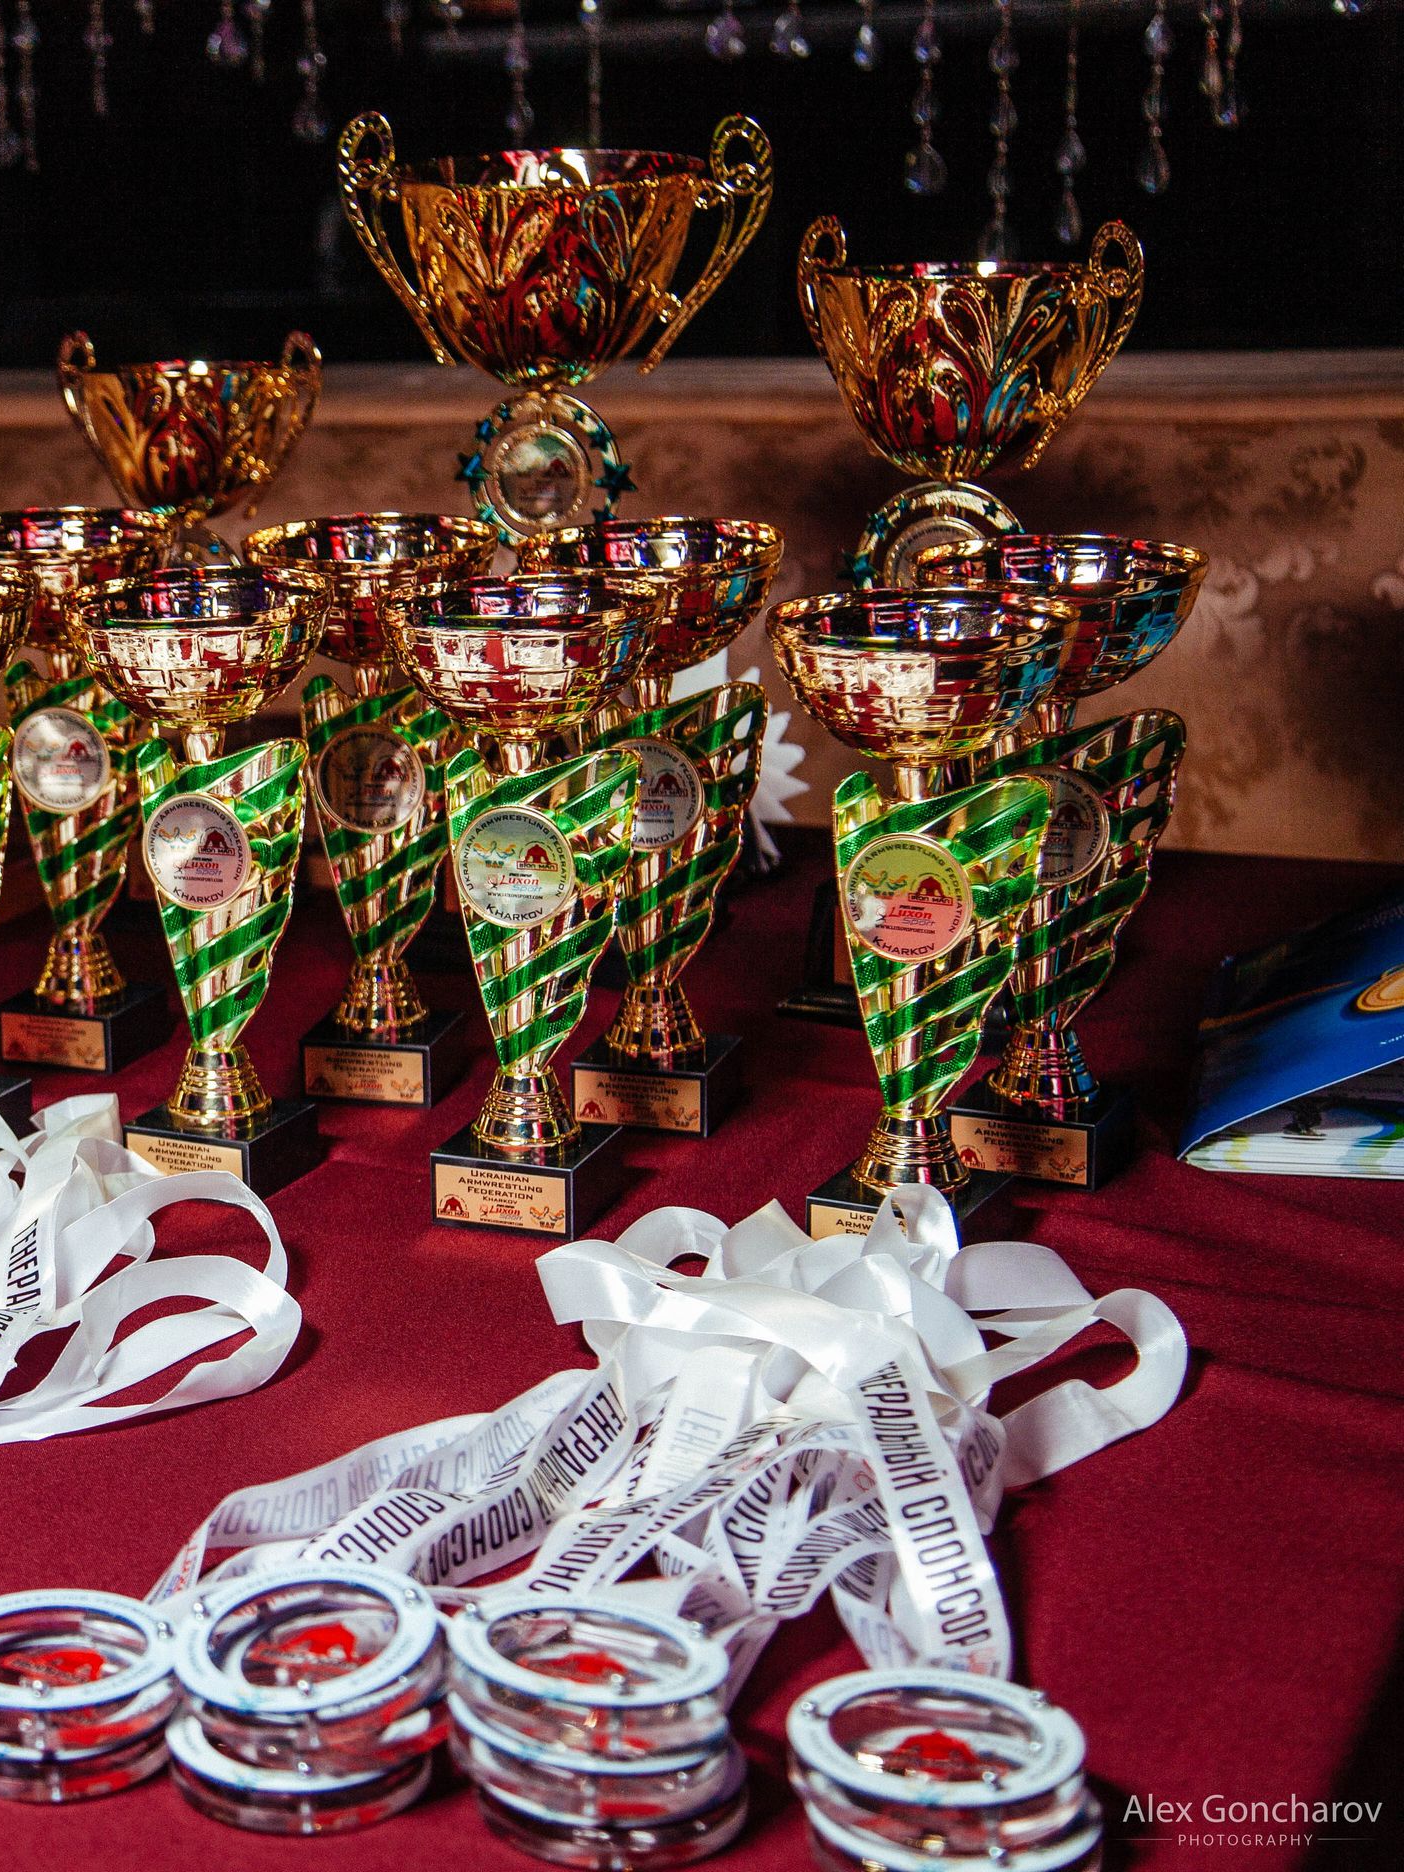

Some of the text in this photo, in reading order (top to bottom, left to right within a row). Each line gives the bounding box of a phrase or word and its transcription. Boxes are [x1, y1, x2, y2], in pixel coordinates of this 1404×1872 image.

[159, 800, 226, 822] ARMWRESTLING
[226, 820, 245, 881] FEDERATION
[460, 813, 569, 898] UKRAINIAN ARMWRESTLING FEDERATION
[499, 873, 540, 886] Luxon
[848, 843, 964, 934] UKRAINIAN ARMWRESTLING FEDERATION
[172, 886, 224, 903] KHARKOV
[485, 903, 544, 921] KHARKOV
[888, 906, 933, 919] Luxon
[871, 935, 936, 956] KHARKOV
[147, 1146, 222, 1164] ARMWRESTLING
[158, 1139, 210, 1153] UKRAINIAN
[155, 1154, 214, 1170] FEDERATION
[458, 1176, 543, 1194] ARMWRESTLING
[470, 1169, 530, 1184] UKRAINIAN
[467, 1185, 534, 1201] FEDERATION
[489, 1205, 521, 1216] Luxon
[5, 1217, 43, 1317] ГЕНЕРА
[319, 1490, 447, 1565] СПОНС
[427, 1486, 535, 1587] СПОНСОР
[528, 1522, 629, 1594] СПОНС
[761, 1524, 863, 1612] СПОНСОР
[901, 1494, 992, 1647] СПОНСОР
